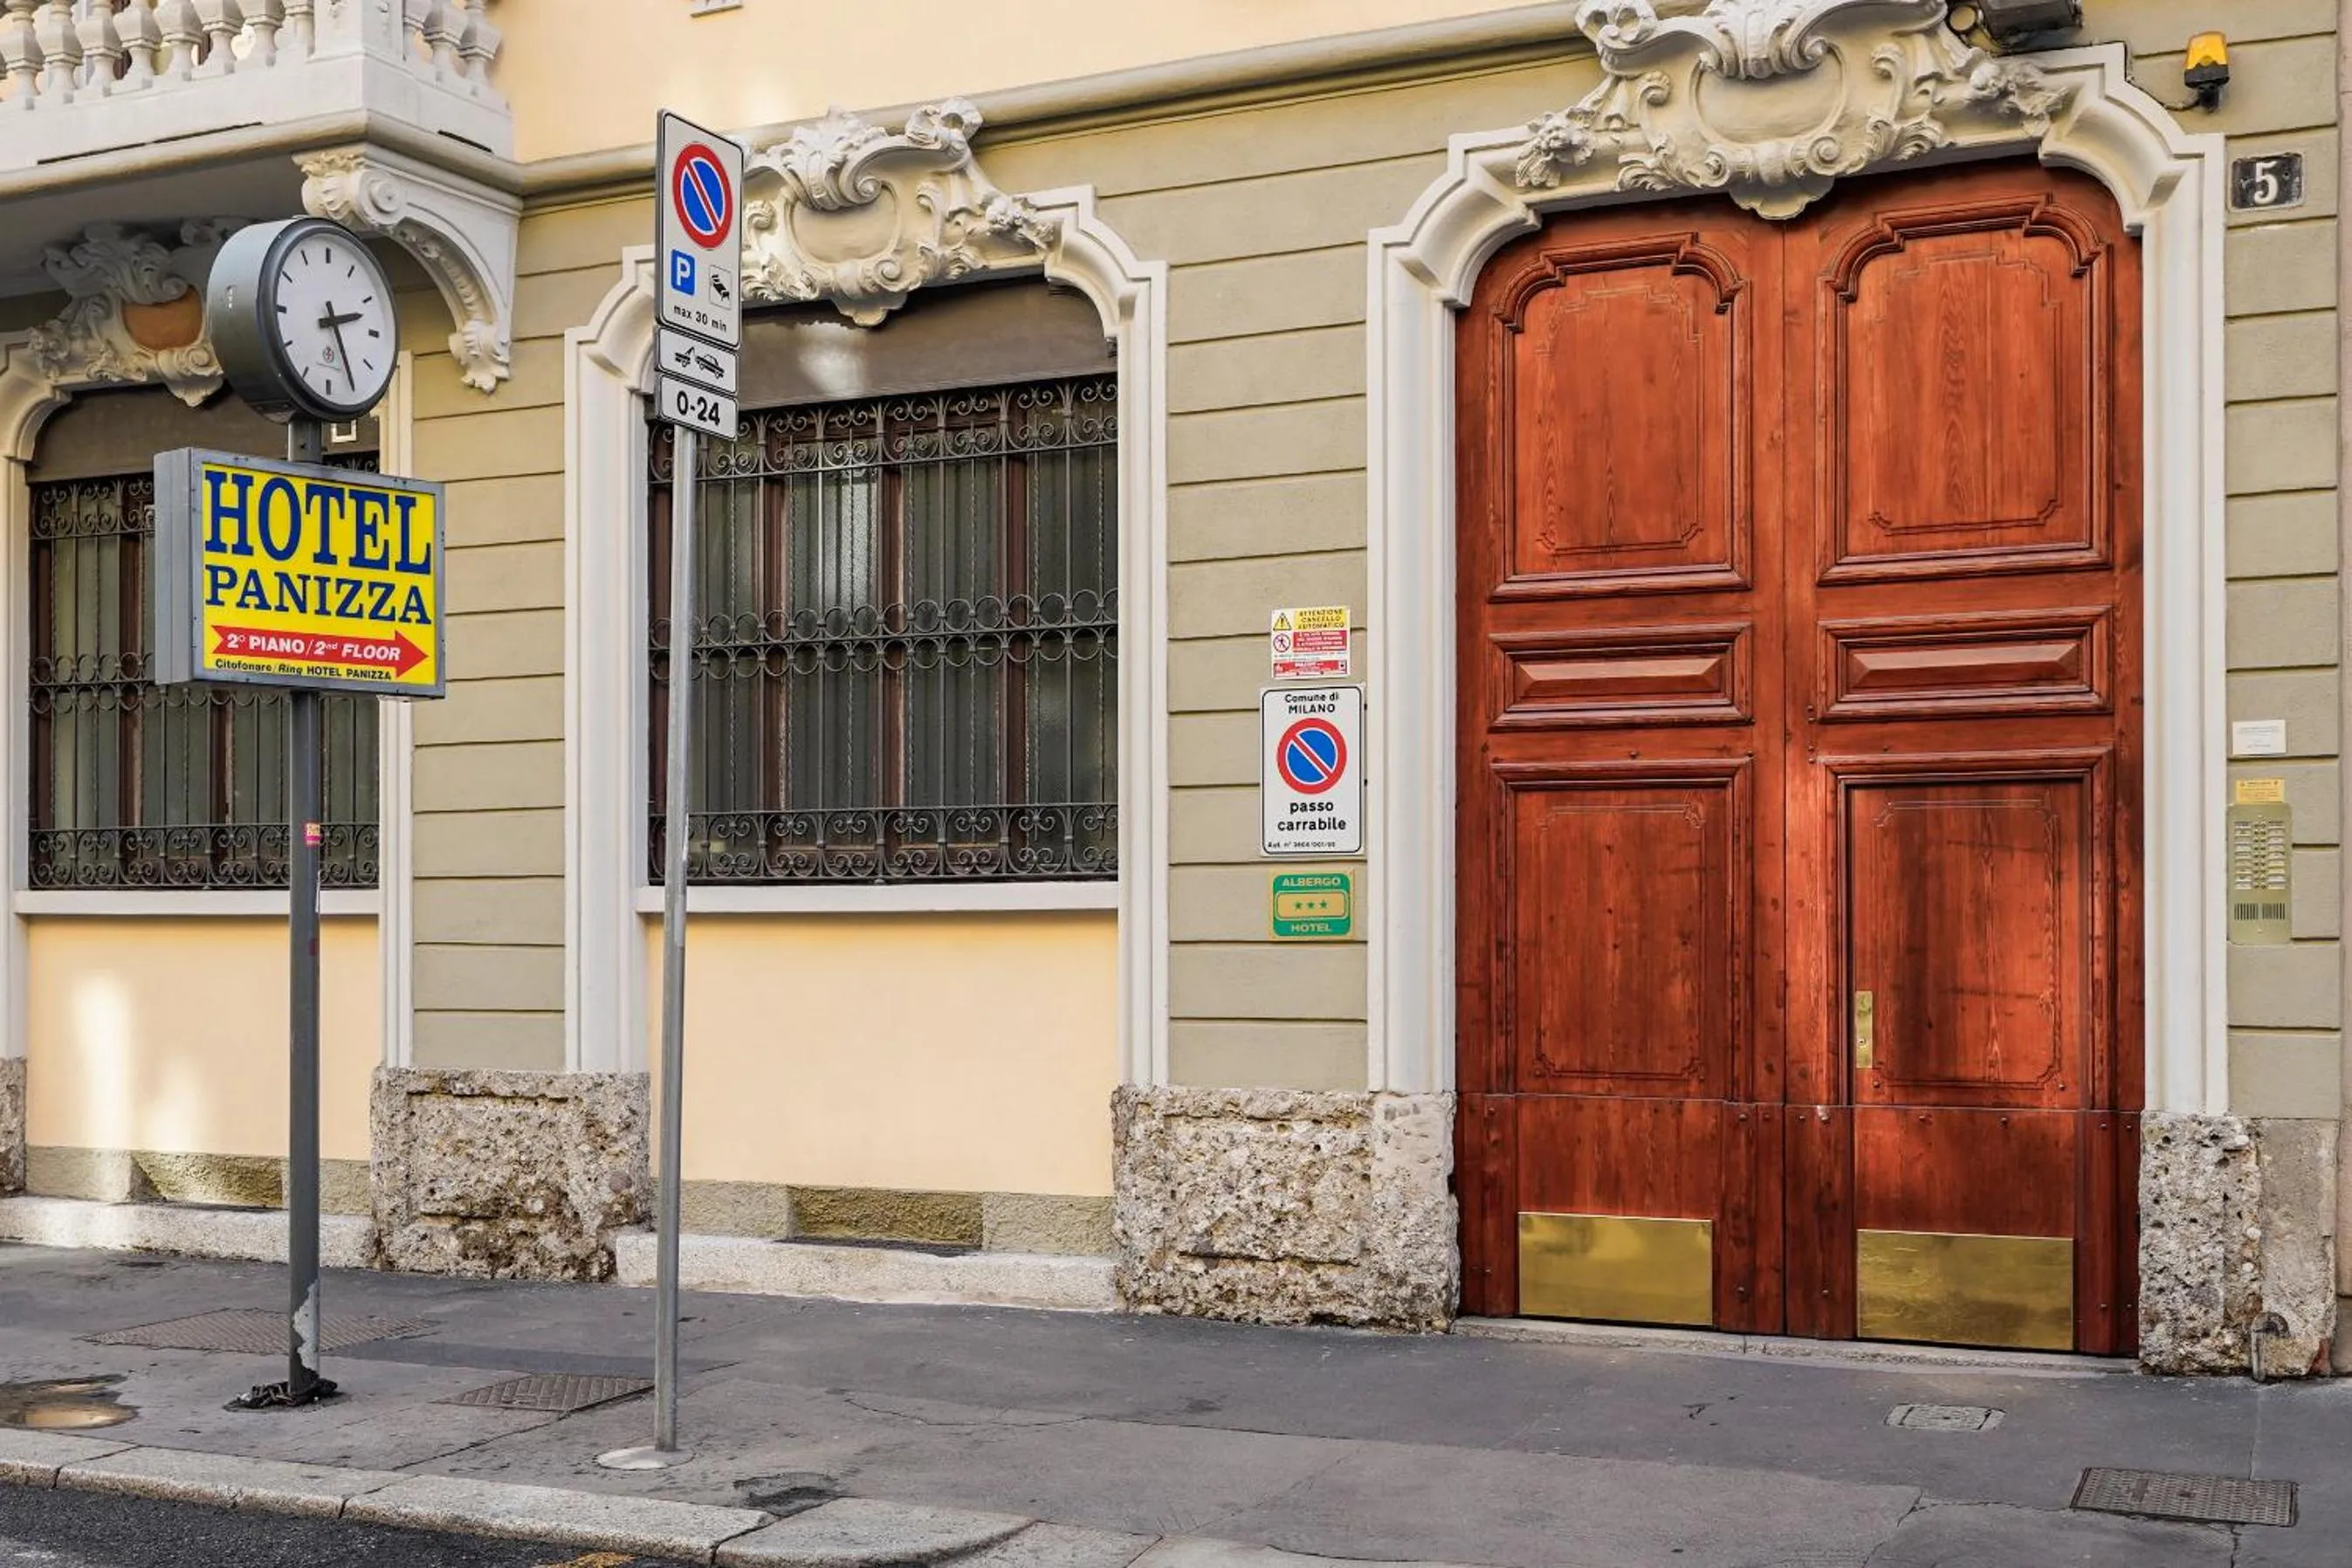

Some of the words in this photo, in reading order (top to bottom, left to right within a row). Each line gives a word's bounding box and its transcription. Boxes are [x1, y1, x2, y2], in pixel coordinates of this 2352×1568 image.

[2253, 161, 2278, 204] 5
[677, 256, 691, 286] P
[674, 306, 692, 320] max
[696, 311, 708, 326] 30
[712, 320, 727, 333] min
[677, 390, 720, 426] 0-24
[205, 470, 431, 575] HOTEL
[205, 564, 432, 625] PANIZZA
[341, 643, 401, 661] FLOOR
[306, 666, 342, 677] HOTEL
[346, 669, 392, 680] PANIZZA
[1284, 694, 1326, 703] Comune
[1329, 691, 1338, 701] di
[1289, 704, 1335, 714] MILANO
[1290, 801, 1334, 815] passo
[1277, 816, 1346, 831] carrabile
[1282, 877, 1342, 887] ALBERGO
[1291, 923, 1331, 933] HOTEL
